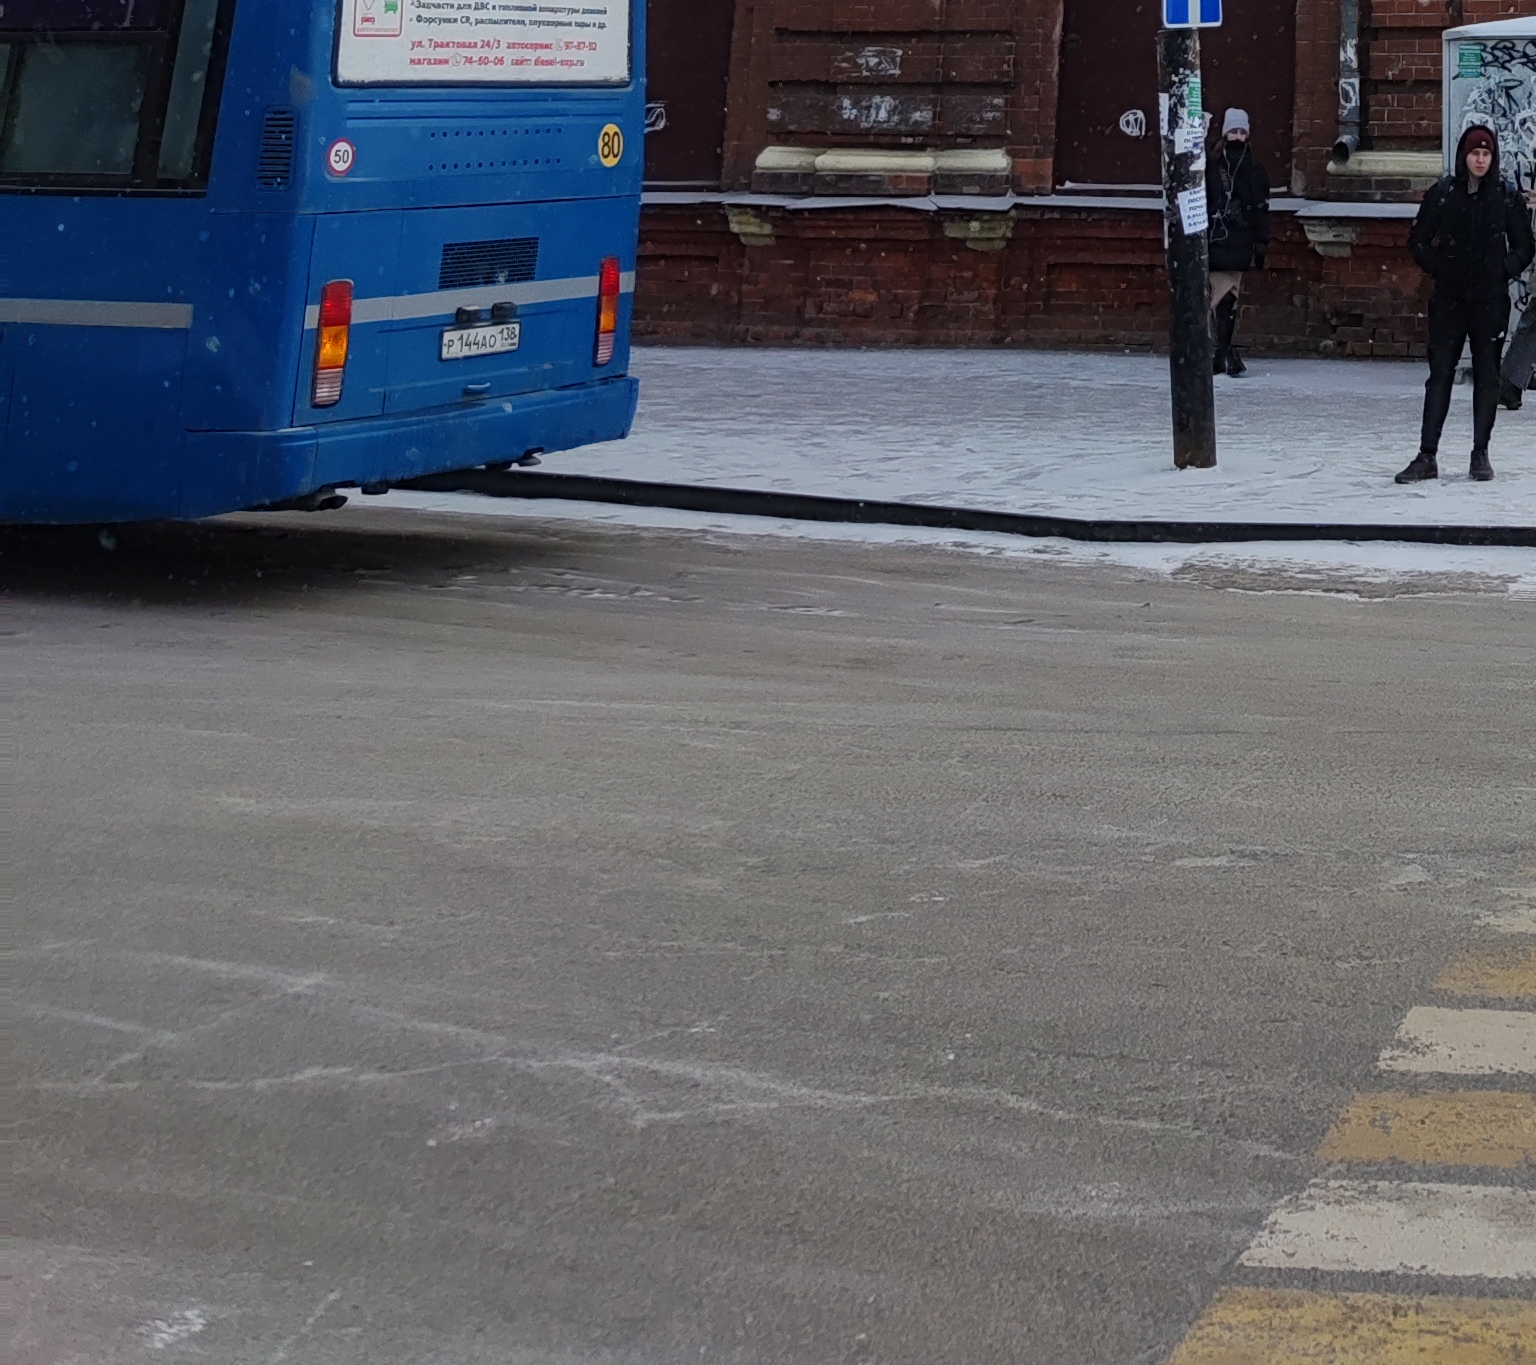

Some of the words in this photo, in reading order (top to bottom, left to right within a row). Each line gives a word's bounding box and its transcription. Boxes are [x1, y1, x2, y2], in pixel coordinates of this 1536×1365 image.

[416, 14, 459, 26] Форсунки
[428, 38, 478, 51] Трактовая
[480, 39, 501, 50] 24/3
[601, 131, 621, 160] 80
[333, 149, 350, 165] 50
